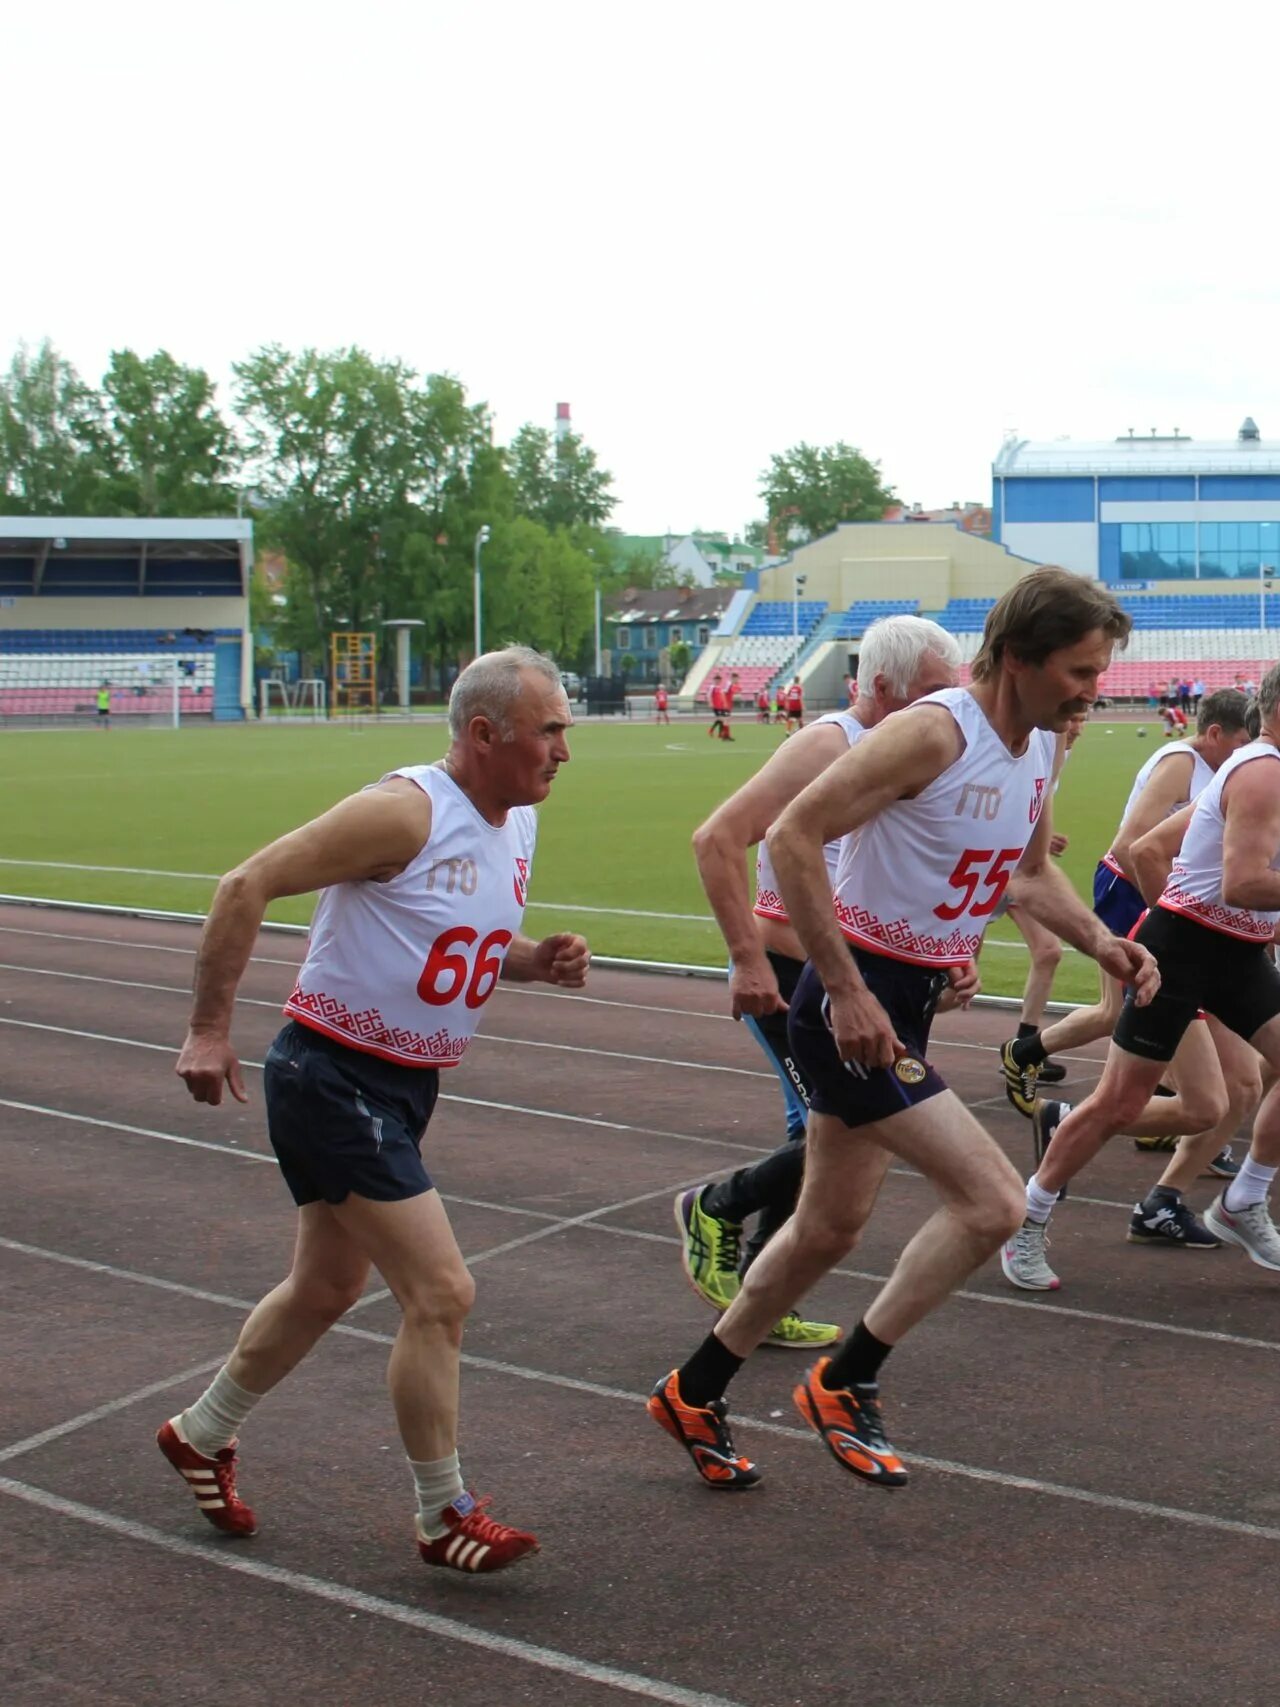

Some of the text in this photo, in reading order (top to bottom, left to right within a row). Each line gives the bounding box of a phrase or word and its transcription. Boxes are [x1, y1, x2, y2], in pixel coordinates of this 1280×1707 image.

[954, 783, 1002, 821] ГТО
[425, 857, 478, 896] ГТО
[932, 847, 1024, 921] 55
[416, 925, 513, 1010] 66
